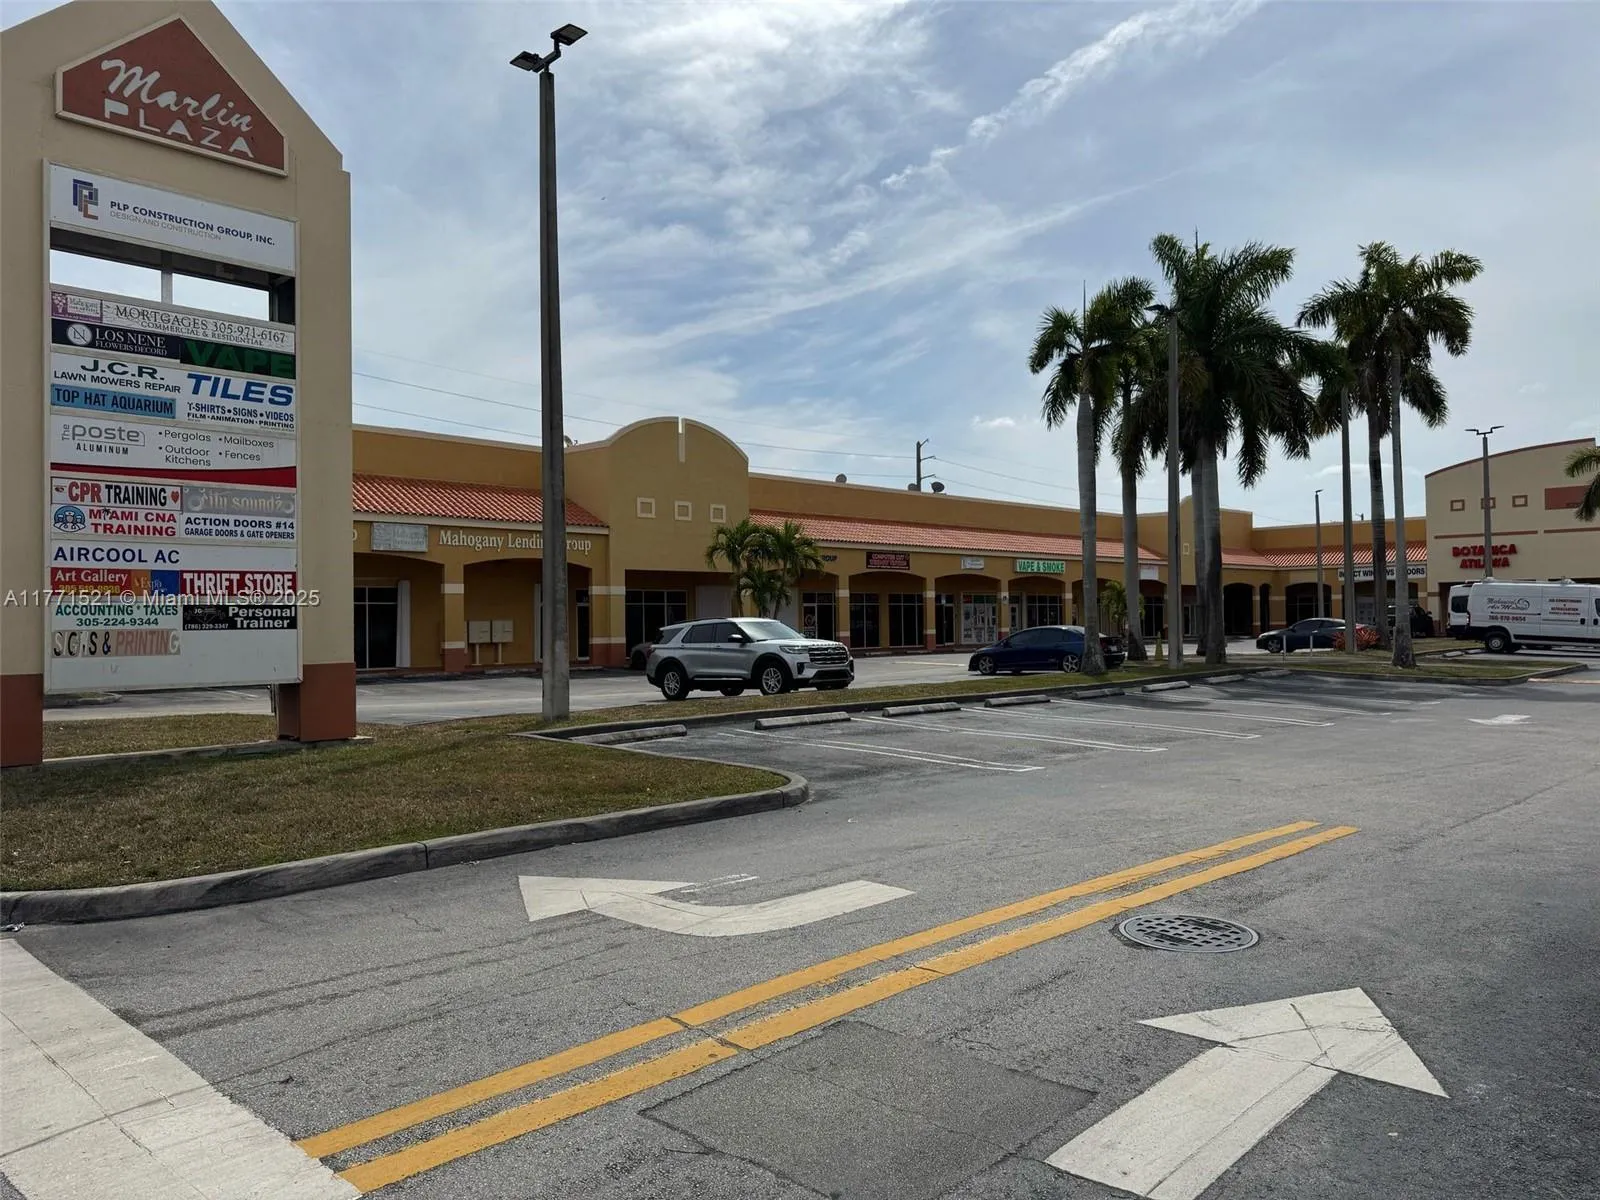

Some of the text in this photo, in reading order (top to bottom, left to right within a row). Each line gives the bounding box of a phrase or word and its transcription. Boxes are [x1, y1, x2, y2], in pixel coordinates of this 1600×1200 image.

[101, 59, 252, 131] Marlin
[104, 98, 254, 158] PLAZA
[110, 201, 275, 246] PLP CONSTRUCTION GROUP, INC.
[110, 210, 221, 240] DESIGN AND CONSTRUCTION
[115, 304, 286, 343] MORTGAGES 305-971-6167
[96, 327, 124, 342] LOS
[141, 320, 263, 346] COMMERCIAL & RESIDENTIAL
[96, 340, 133, 352] FLOWERS
[184, 340, 292, 378] VAPE
[80, 360, 165, 380] J.C.R.
[54, 370, 181, 394] LAWN MOWERS REPAIR
[187, 373, 294, 406] TILES
[55, 388, 173, 414] TOP HAT AQUARIUM
[188, 402, 294, 422] T-SHIRTS SIGNS VIDEOS
[211, 415, 254, 424] ANIMATION
[258, 420, 294, 429] PRINTING
[62, 424, 140, 442] The poste
[164, 429, 212, 442] Pergolas
[76, 442, 128, 454] ALUMINUM
[165, 444, 210, 456] Outdoor
[224, 436, 274, 448] Mailboxes
[165, 455, 211, 466] Kitchens
[224, 450, 260, 461] Fences
[68, 481, 167, 506] CPR TRAINING
[144, 512, 176, 523] CNA
[185, 517, 294, 530] ACTION DOORS #14
[90, 523, 176, 536] TRAINING
[185, 528, 213, 536] GARAGE
[215, 529, 238, 537] DOORS
[240, 530, 246, 538] &
[266, 532, 294, 540] OPENERS
[439, 530, 504, 552] Mahogany
[508, 533, 544, 549] Lendi
[567, 539, 592, 555] roup
[54, 546, 180, 564] AIRCOOL AC
[1018, 561, 1034, 571] VAPE
[1042, 562, 1064, 572] SMOKE
[54, 570, 128, 586] Art Gallery
[183, 572, 292, 595] THRIFT STORE
[56, 604, 178, 616] ACCOUNTING TAXES
[228, 606, 296, 617] Personal
[76, 618, 159, 626] 305-224-9344
[234, 618, 290, 628] Trainer
[102, 632, 111, 655] &
[116, 630, 180, 655] PRINTING
